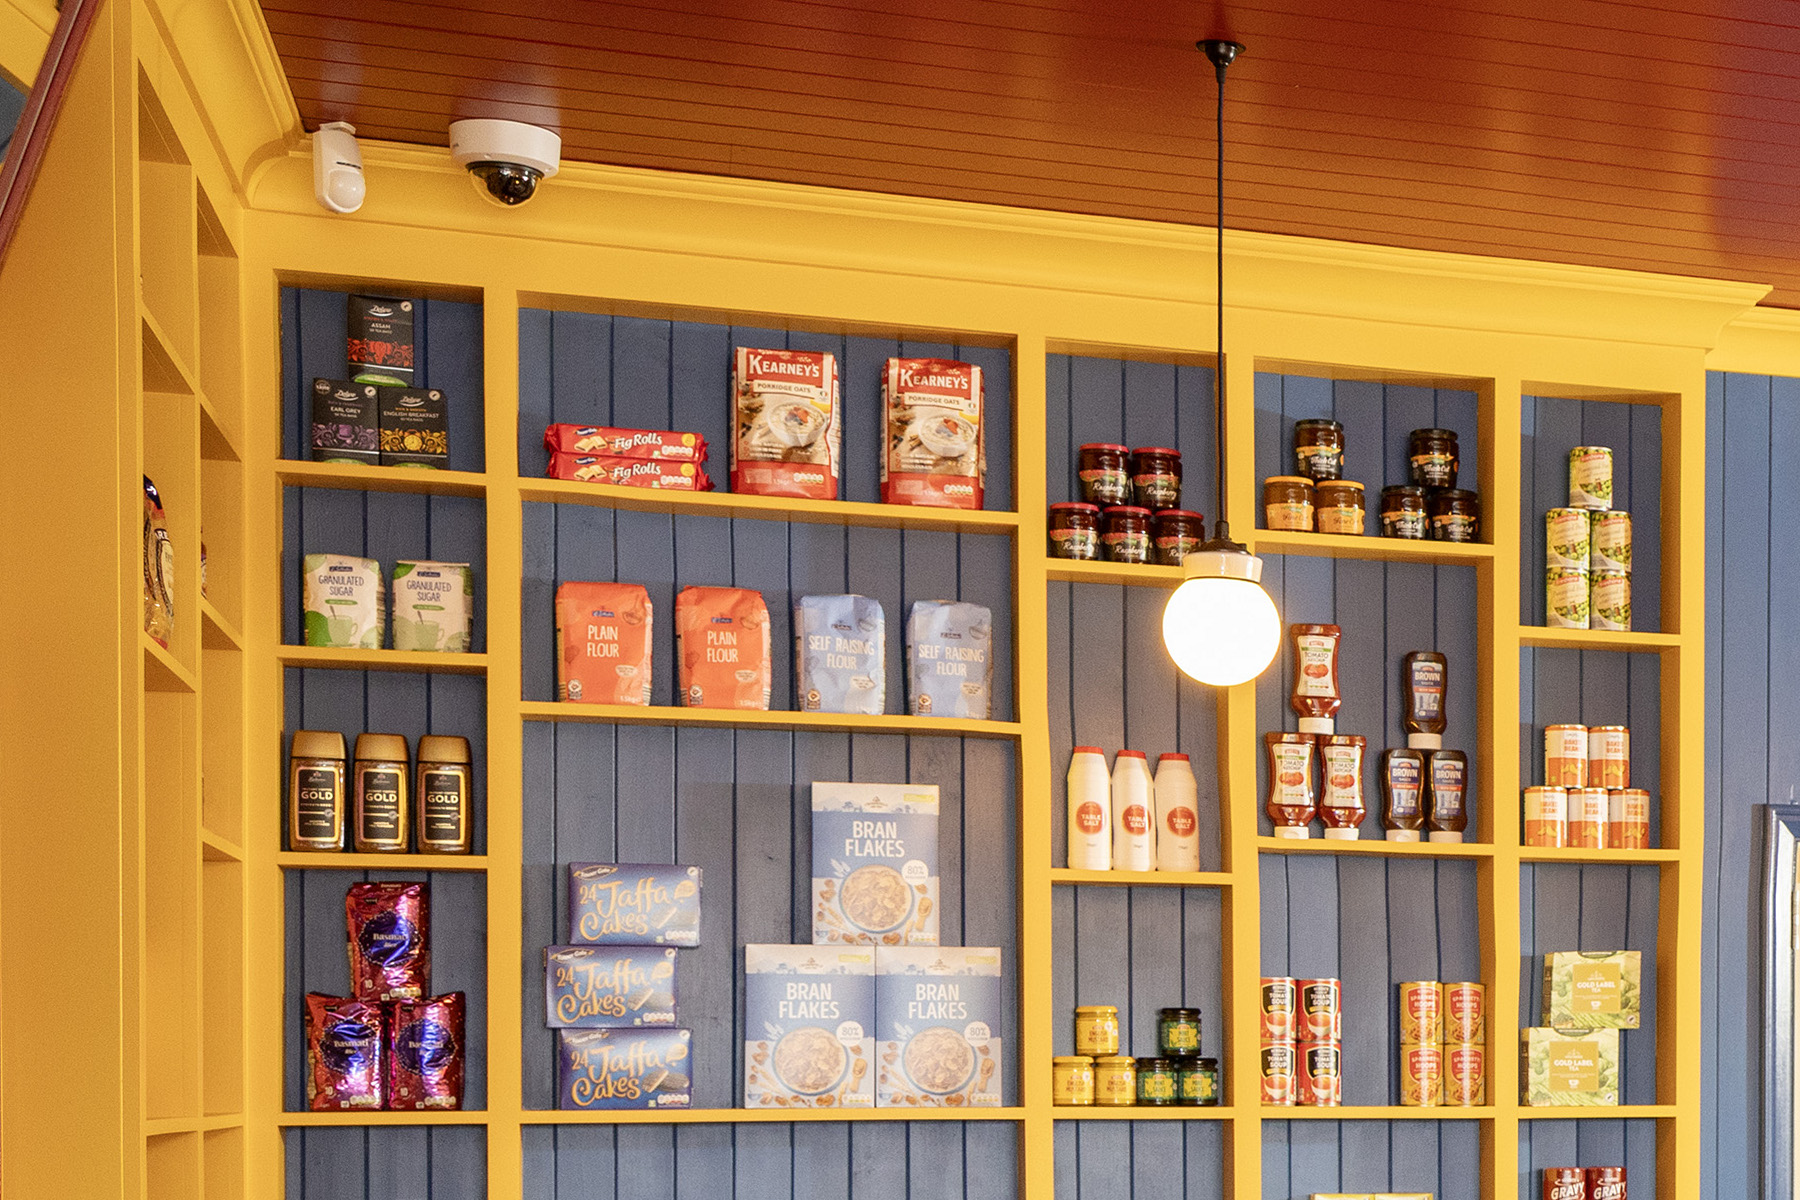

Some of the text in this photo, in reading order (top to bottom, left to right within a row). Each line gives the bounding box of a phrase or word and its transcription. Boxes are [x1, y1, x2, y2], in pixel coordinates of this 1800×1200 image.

[749, 354, 820, 378] KEARNEY'S
[758, 382, 811, 394] PORRIDGE OATS
[900, 370, 968, 390] KEARNEY'S
[908, 395, 961, 406] PORRIDGE OATS
[614, 432, 662, 450] Fig Rolls
[613, 462, 662, 479] Fig Rolls
[318, 575, 364, 586] GRANULATED
[406, 580, 452, 592] GRANULATED
[330, 586, 354, 597] SUGAR
[417, 592, 440, 602] SUGAR
[587, 624, 618, 641] PLAIN
[707, 630, 738, 646] PLAIN
[586, 642, 620, 658] FLOUR
[808, 635, 875, 656] SELF RAISING
[918, 644, 985, 663] SELF RAISING
[706, 648, 739, 663] FLOUR
[826, 654, 857, 670] FLOUR
[1304, 652, 1329, 660] TOMATO
[936, 662, 968, 677] FLOUR
[1415, 672, 1440, 682] BROWN
[1279, 760, 1304, 768] TOMATO
[1330, 762, 1356, 770] TOMATO
[1392, 768, 1418, 778] BROWN
[1436, 769, 1462, 780] BROWN
[301, 791, 334, 800] GOLD
[366, 793, 398, 802] GOLD
[428, 794, 459, 804] GOLD
[852, 820, 897, 839] BRAN
[845, 838, 905, 858] FLAKES
[907, 866, 926, 875] 80%
[579, 877, 672, 918] 24 Jaffa
[580, 910, 648, 941] Cakes
[373, 932, 408, 941] Basmat
[557, 958, 649, 1000] 24 Jaffa
[786, 982, 832, 1000] BRAN
[916, 984, 960, 1001] BRAN
[557, 992, 626, 1024] Cakes
[778, 1000, 840, 1020] FLAKES
[908, 1002, 967, 1020] FLAKES
[842, 1026, 859, 1036] 80%
[970, 1027, 986, 1036] 80%
[334, 1040, 368, 1048] Basmati
[571, 1040, 663, 1084] 24 Jaffa
[572, 1074, 642, 1106] Cakes
[1551, 1182, 1585, 1200] GRAVY
[1594, 1182, 1626, 1200] GRAVY
